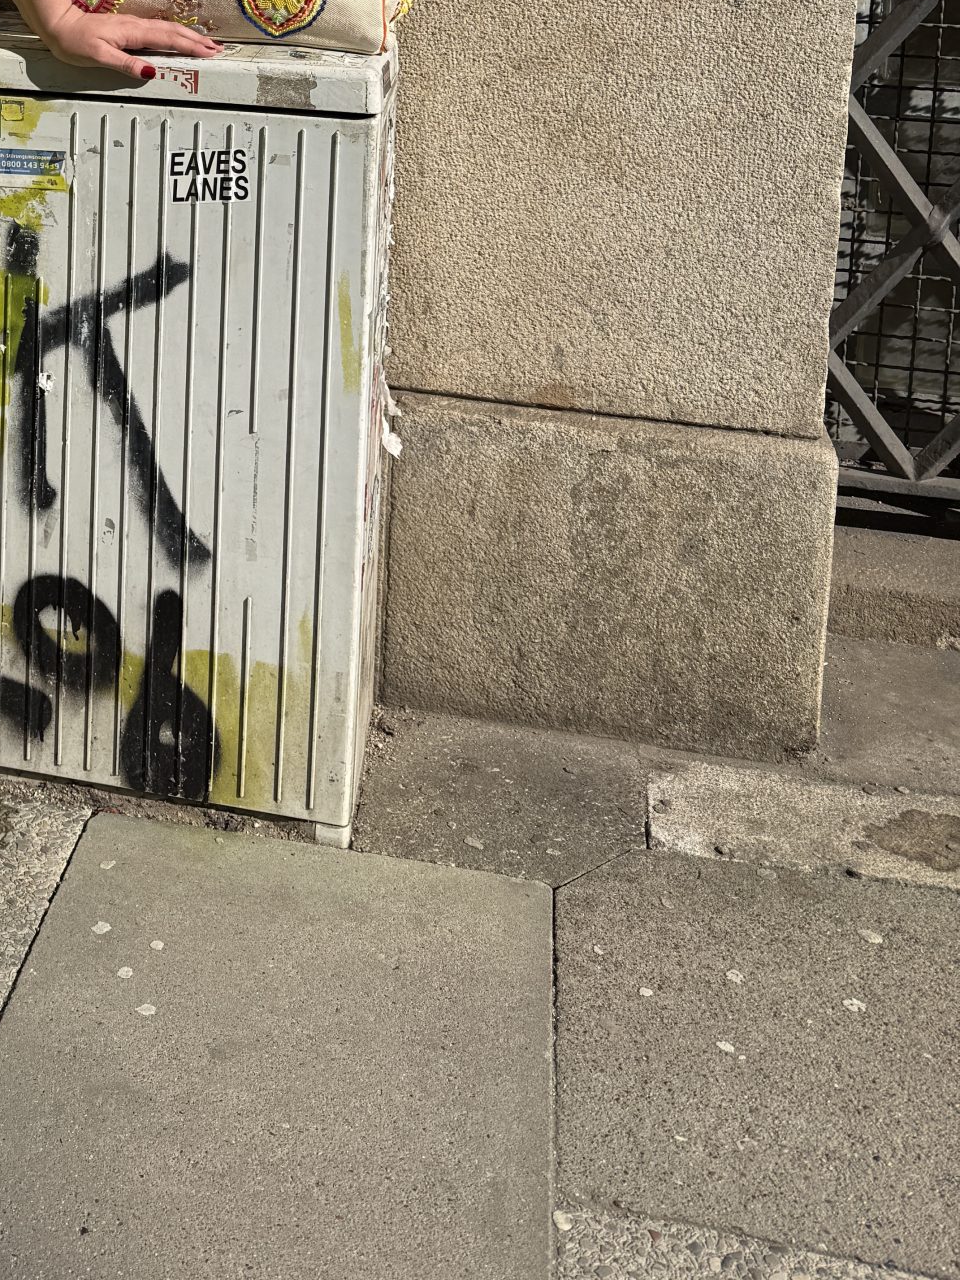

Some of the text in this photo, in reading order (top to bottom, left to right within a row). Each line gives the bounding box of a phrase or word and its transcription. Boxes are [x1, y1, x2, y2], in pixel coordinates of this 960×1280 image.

[1, 160, 21, 168] 0800
[23, 161, 38, 169] 143
[170, 149, 246, 176] EAVES
[173, 175, 249, 202] LANES
